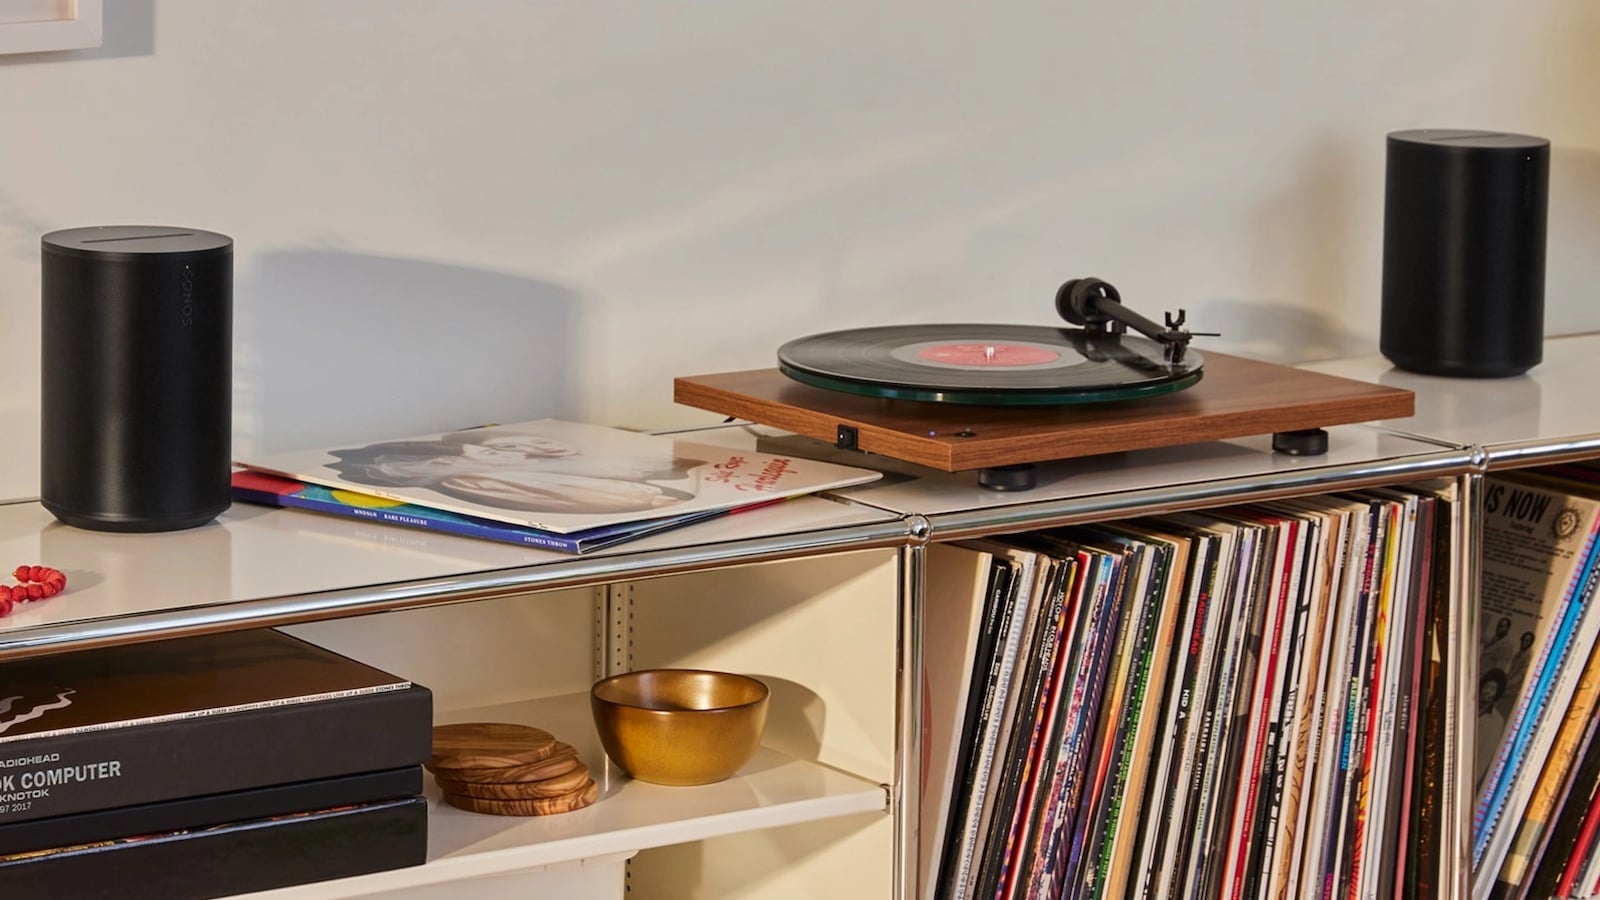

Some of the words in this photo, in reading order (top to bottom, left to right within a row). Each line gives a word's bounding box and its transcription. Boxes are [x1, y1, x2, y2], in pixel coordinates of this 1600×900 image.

[182, 270, 193, 327] SONOS
[400, 516, 428, 526] PLEASURE
[1504, 492, 1552, 524] NOW
[524, 536, 546, 546] STONES
[546, 538, 568, 548] THROW
[1368, 544, 1374, 554] TY
[1363, 558, 1372, 593] SEGALL
[1056, 591, 1065, 606] HOT
[1139, 619, 1145, 627] ON
[1189, 592, 1208, 654] RADIOHEAD
[1041, 646, 1052, 671] HEADS
[1128, 662, 1136, 683] DEEPER
[1219, 671, 1227, 694] ARCADE
[1119, 684, 1132, 728] UNDERSTANDING
[1180, 688, 1190, 707] KID
[1345, 676, 1358, 730] FREEDOM'S
[1178, 710, 1186, 719] A
[1400, 695, 1408, 730] slowdive
[1199, 710, 1212, 752] DARKSIDE
[1183, 731, 1195, 772] RADIOHEAD
[1340, 732, 1351, 769] GOBLIN
[0, 775, 15, 792] K
[21, 760, 121, 789] COMPUTER
[12, 802, 32, 812] 2017
